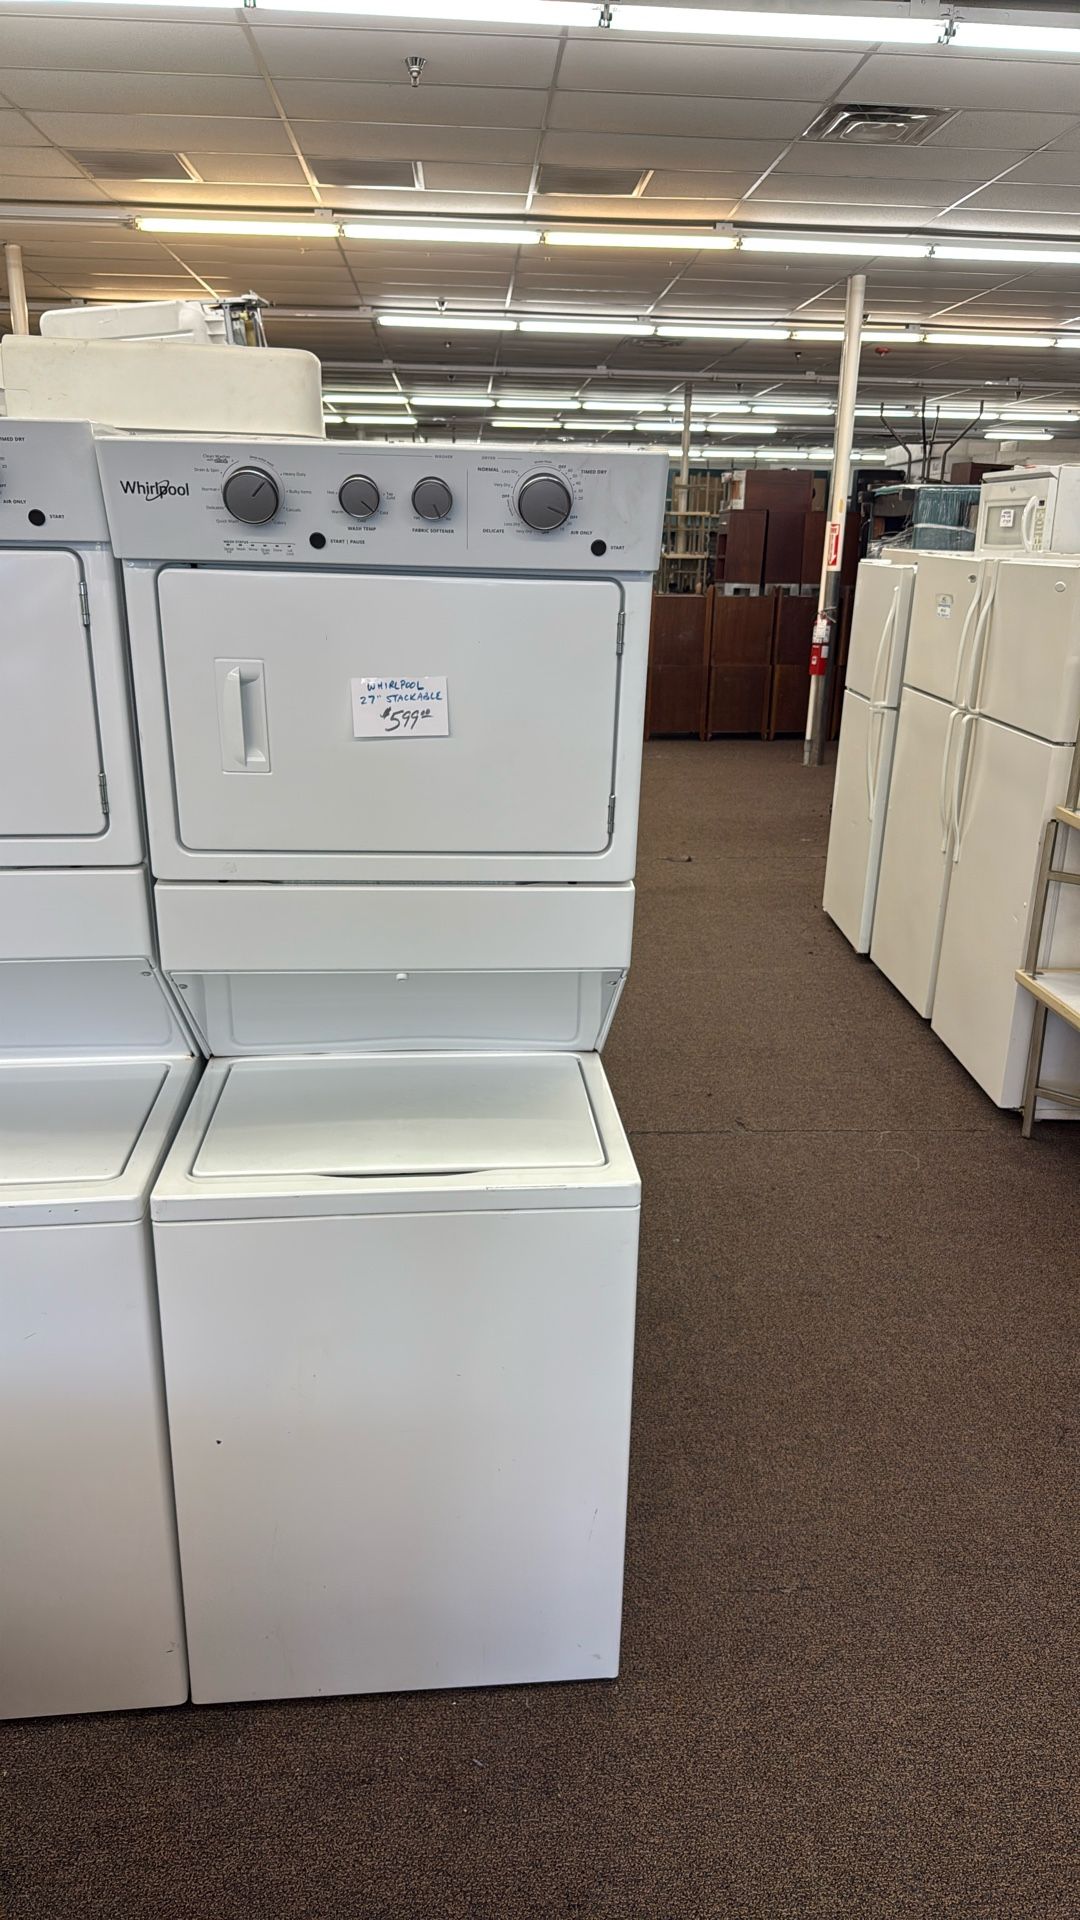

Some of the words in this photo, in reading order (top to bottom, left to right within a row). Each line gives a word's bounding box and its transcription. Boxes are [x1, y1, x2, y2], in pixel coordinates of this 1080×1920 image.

[120, 480, 189, 501] Whirlpool
[367, 679, 424, 691] WHIRLPOOL
[360, 694, 381, 705] 27"
[386, 691, 442, 703] STACKABLE
